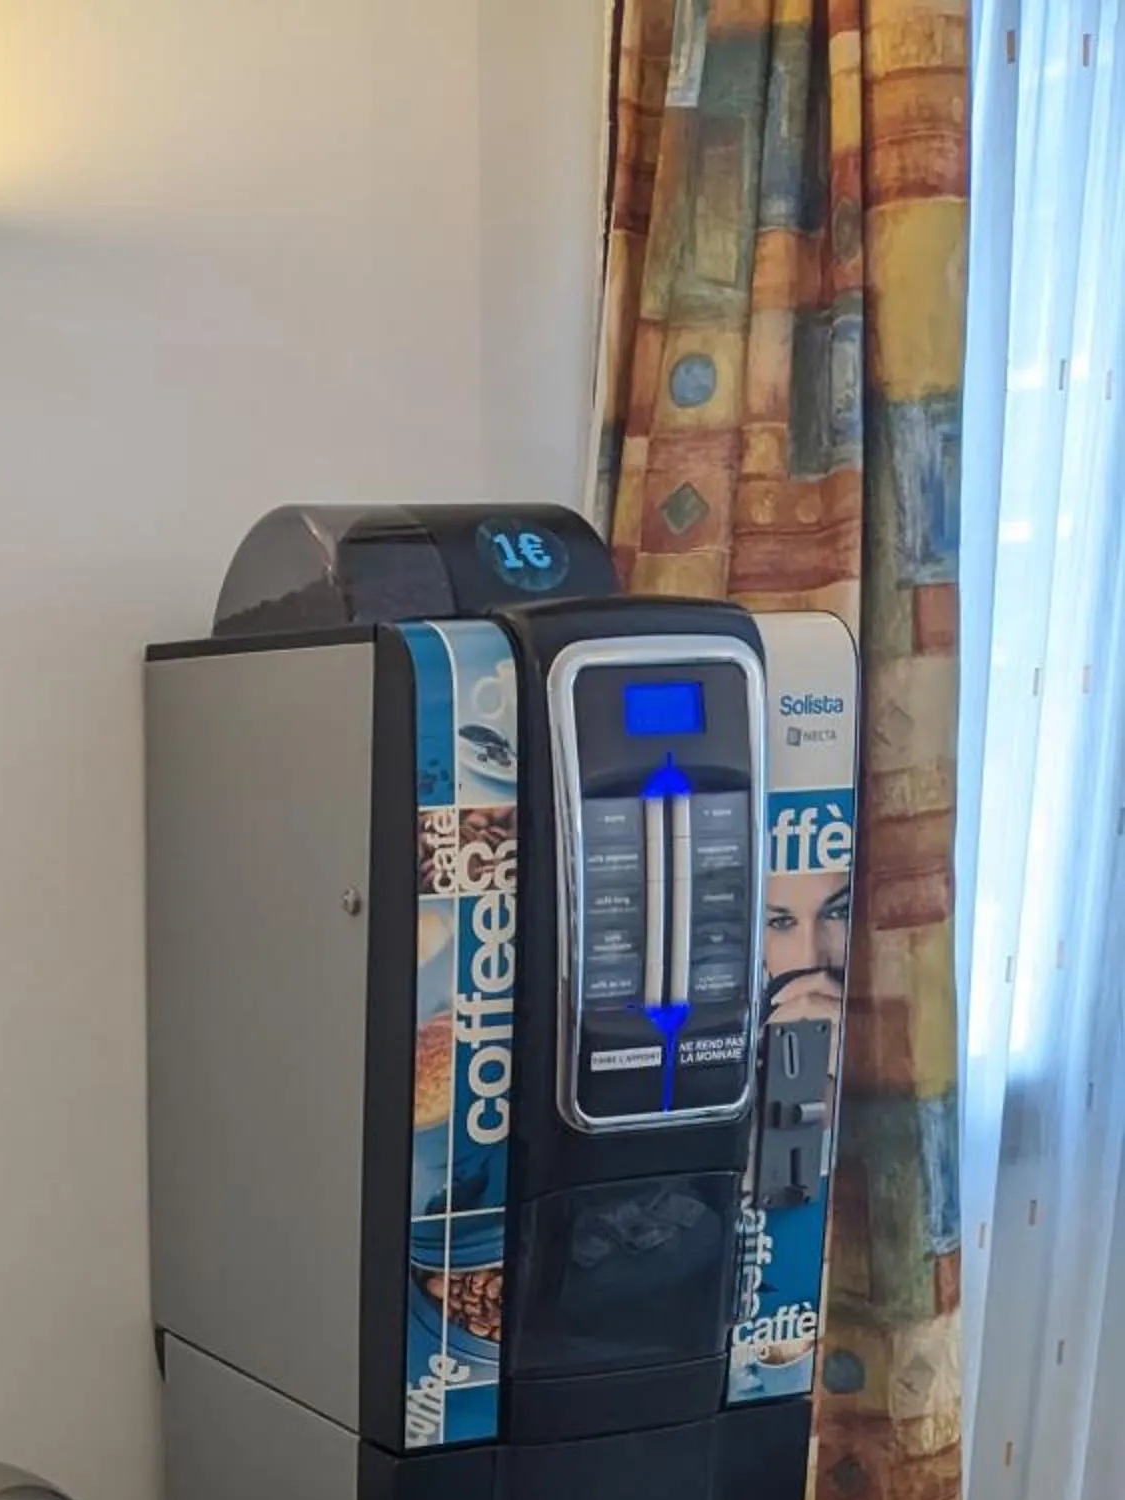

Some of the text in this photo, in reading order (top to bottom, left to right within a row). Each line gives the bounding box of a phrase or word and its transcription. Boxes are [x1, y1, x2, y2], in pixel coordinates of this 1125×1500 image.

[493, 533, 551, 568] 1€
[779, 694, 844, 717] Solista
[455, 891, 517, 1145] coffee
[679, 1041, 694, 1052] NE
[695, 1039, 723, 1051] REND
[680, 1052, 694, 1063] LA
[732, 1301, 818, 1345] caffè
